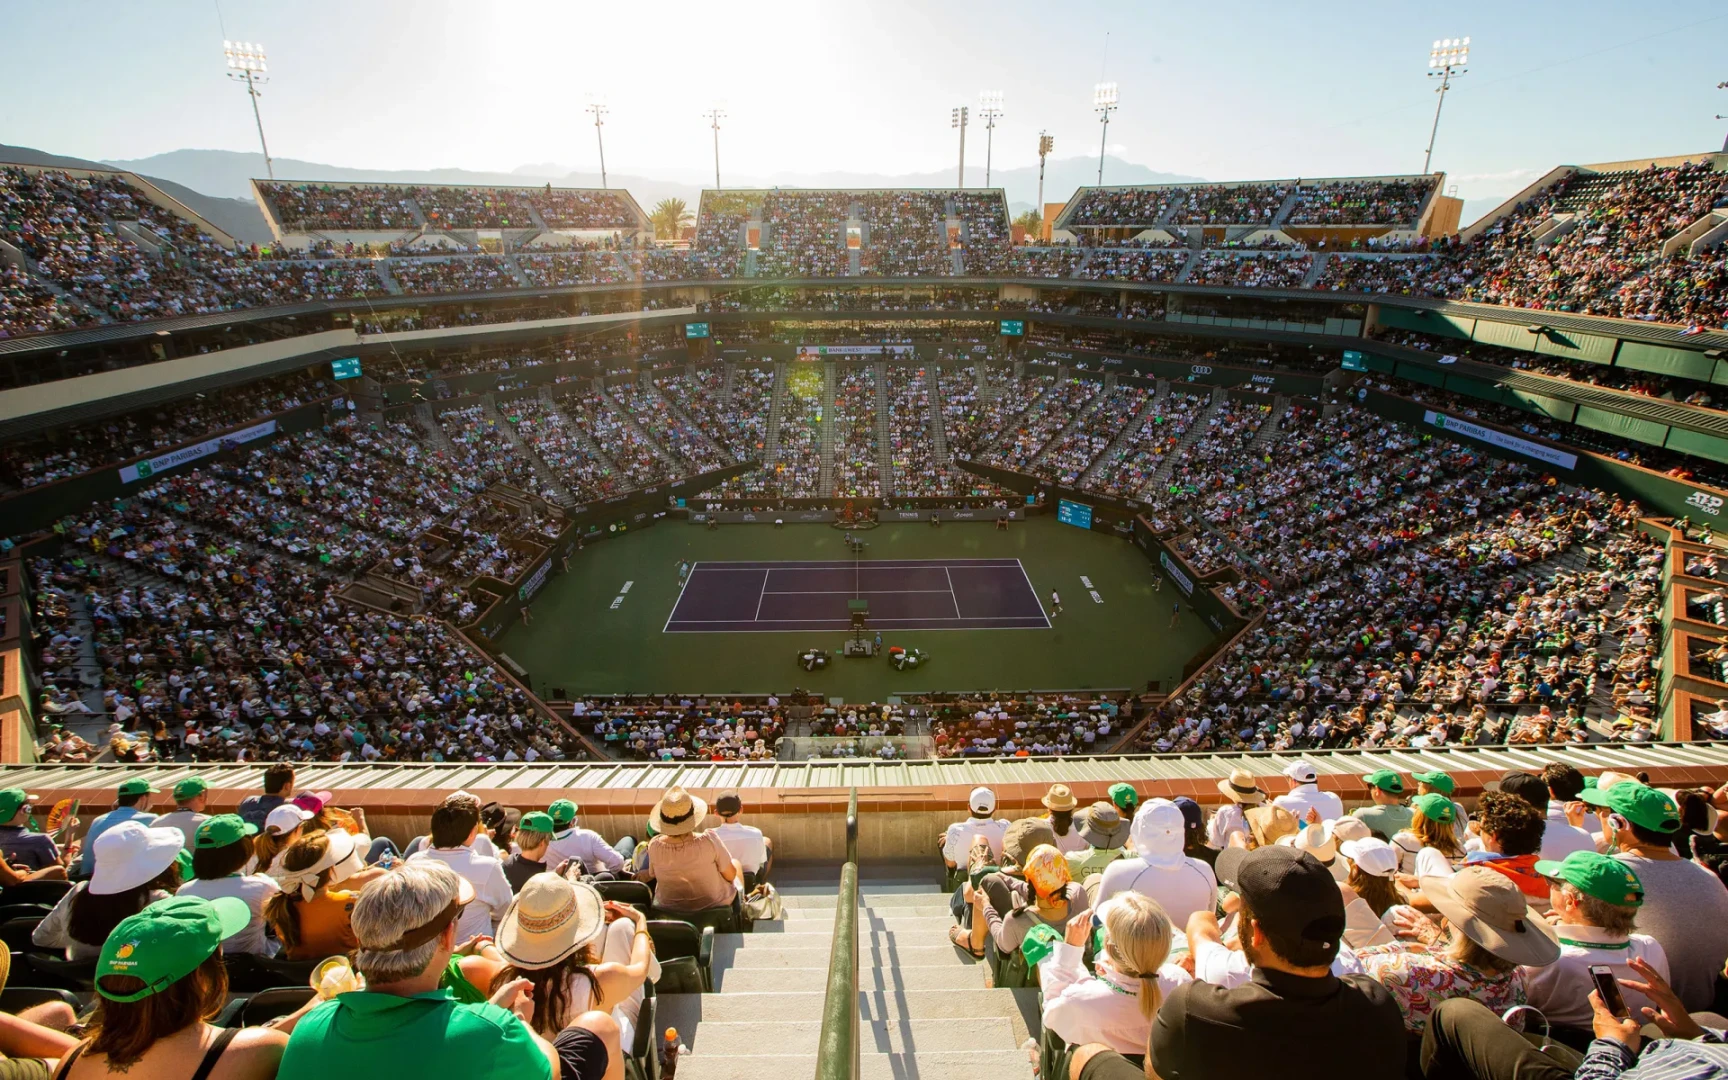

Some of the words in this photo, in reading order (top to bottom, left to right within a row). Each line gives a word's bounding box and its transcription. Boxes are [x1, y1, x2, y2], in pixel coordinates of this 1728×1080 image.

[1045, 351, 1073, 360] ORACLE
[1251, 374, 1276, 384] Hertz
[1446, 418, 1459, 428] BNP
[1459, 424, 1486, 438] PARIBAS
[152, 457, 170, 469] BNP
[170, 446, 203, 463] PARIBAS
[1686, 491, 1724, 508] ATP
[1701, 504, 1721, 516] 1000
